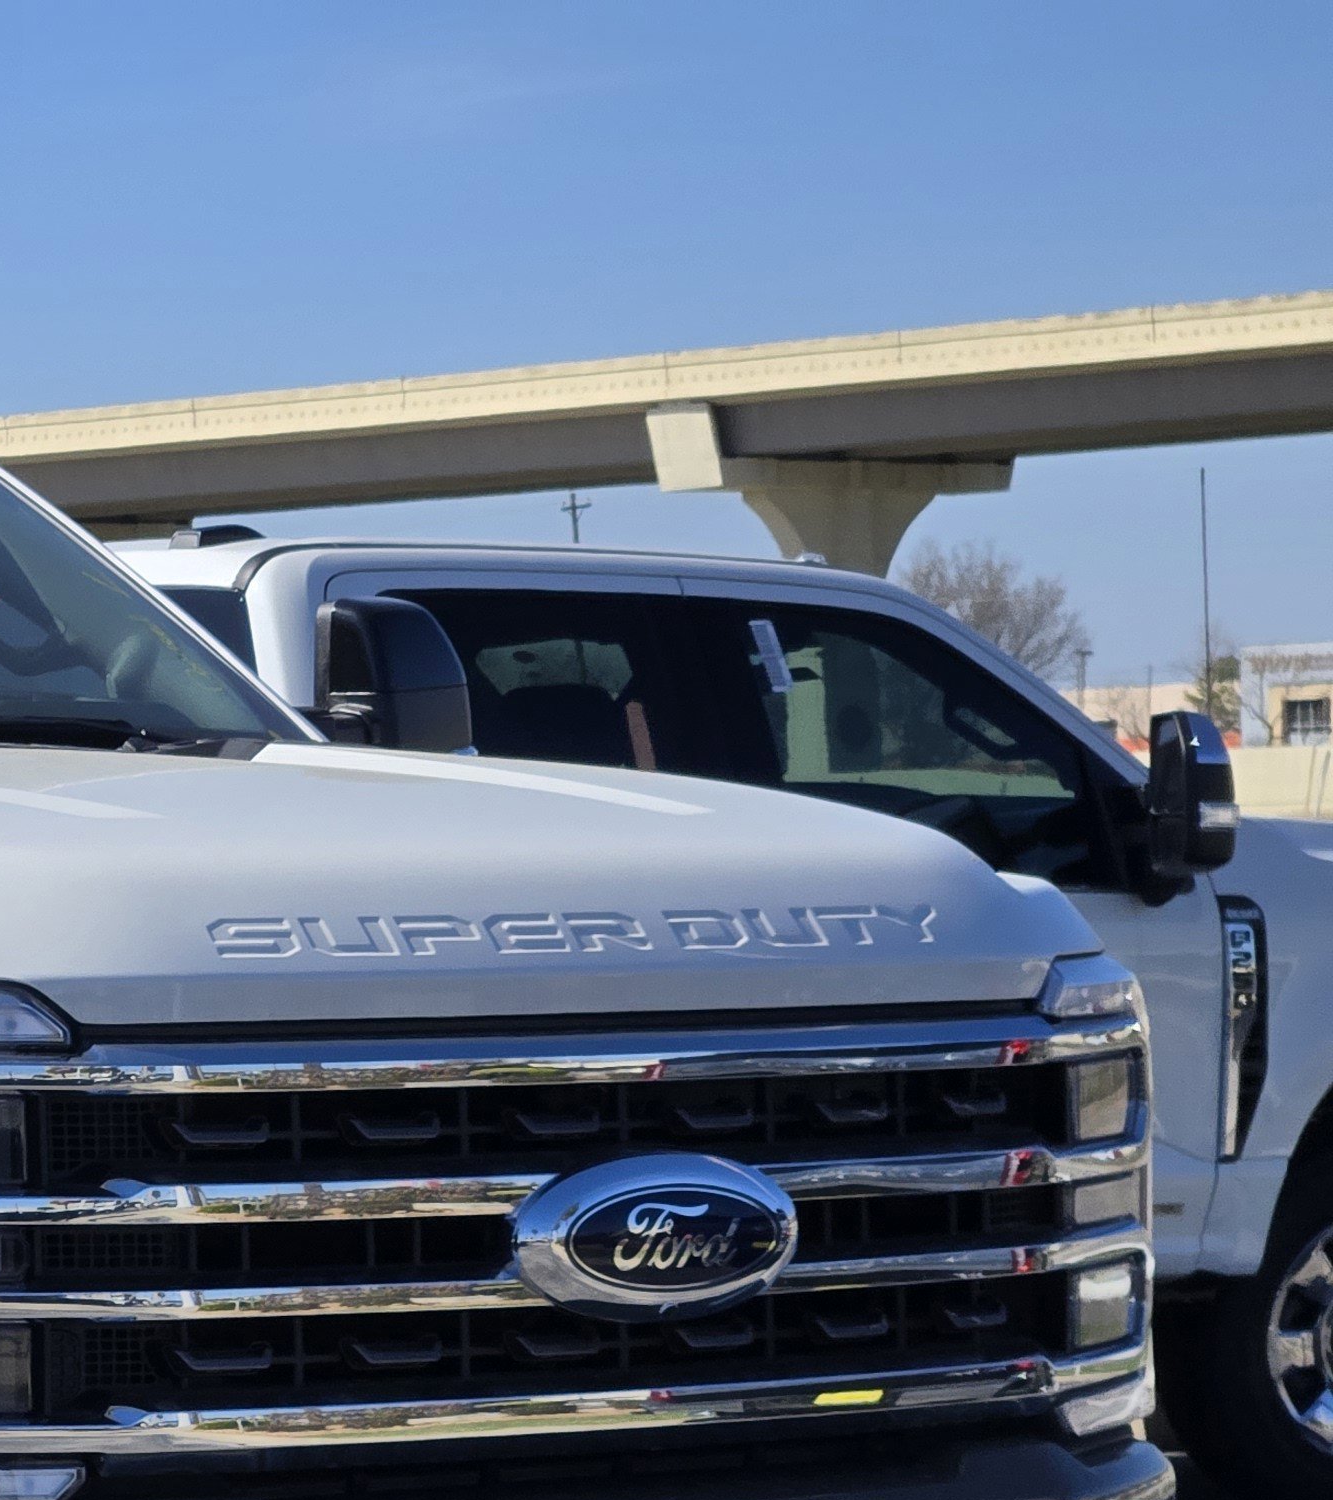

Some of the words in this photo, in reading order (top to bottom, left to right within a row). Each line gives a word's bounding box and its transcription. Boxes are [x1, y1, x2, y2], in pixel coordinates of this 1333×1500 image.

[206, 912, 653, 958] SUPER
[660, 905, 937, 950] DUTY
[613, 1203, 740, 1271] Ford
